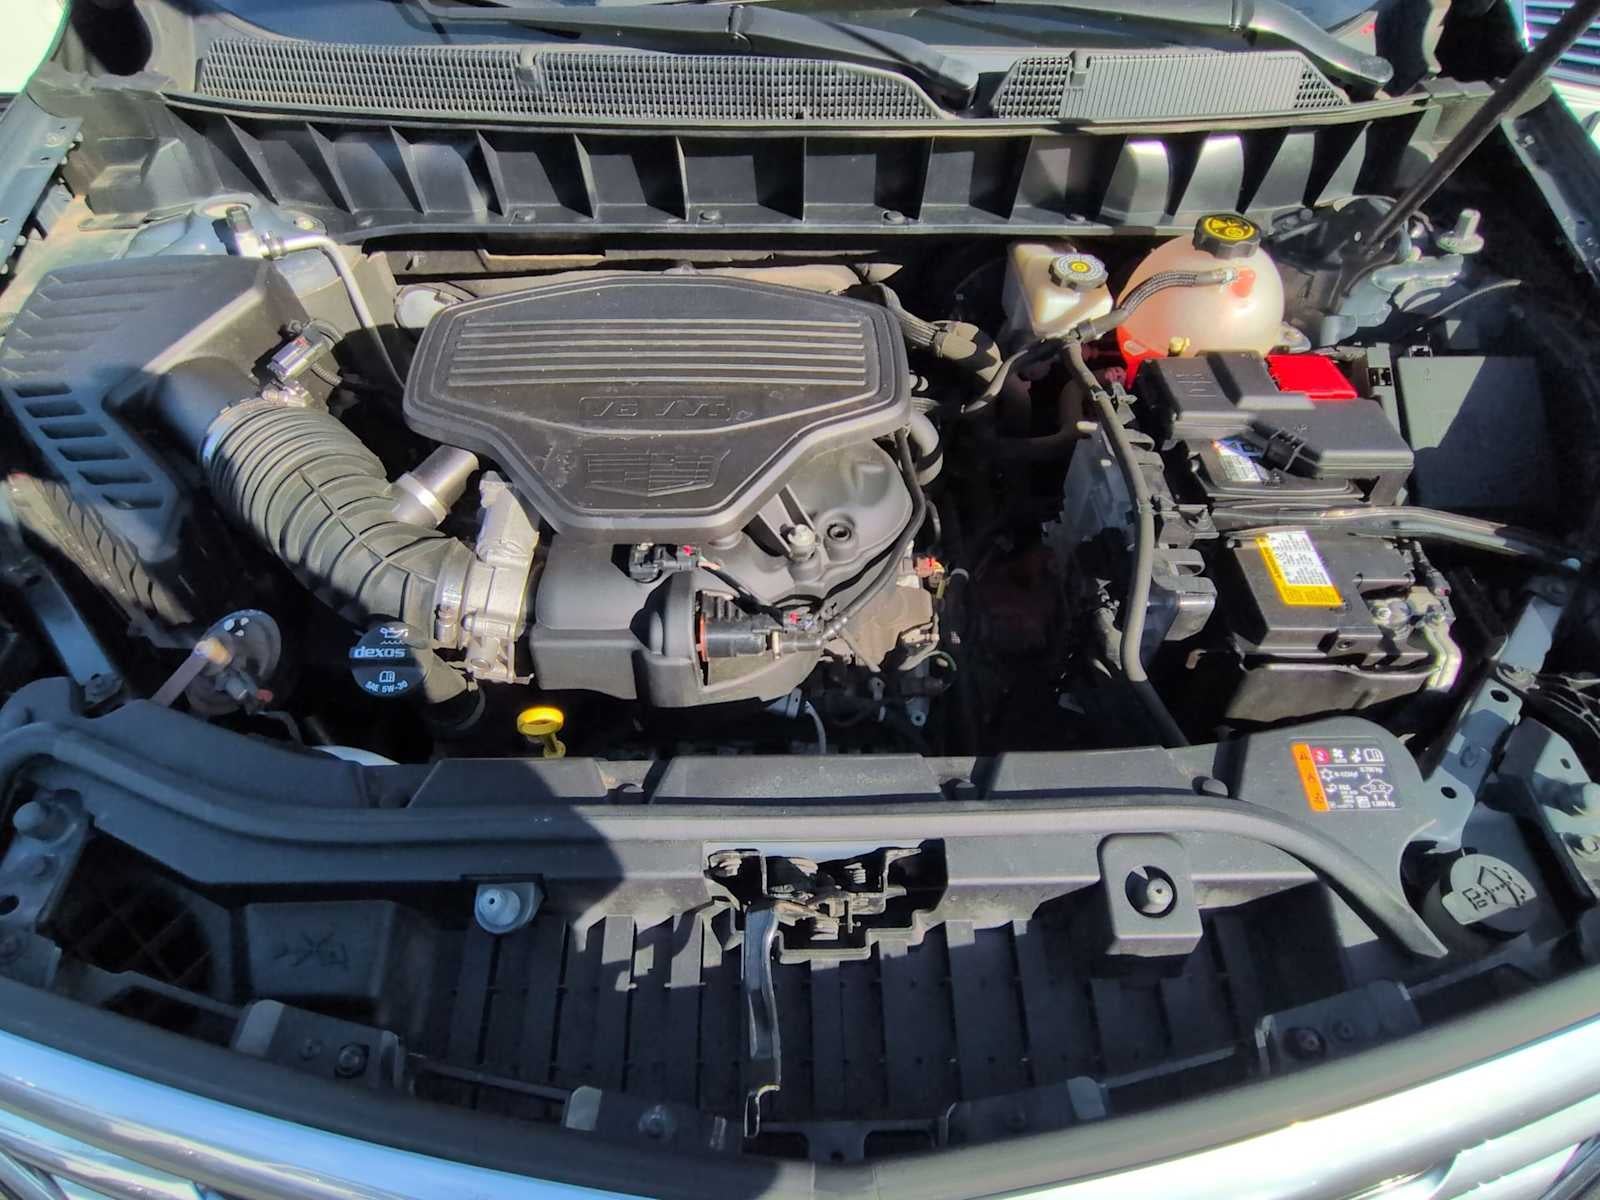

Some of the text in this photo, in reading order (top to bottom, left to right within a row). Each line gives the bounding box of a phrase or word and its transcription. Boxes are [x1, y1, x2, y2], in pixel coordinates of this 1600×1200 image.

[354, 646, 407, 658] dexos
[365, 680, 408, 693] SAE 5W-30
